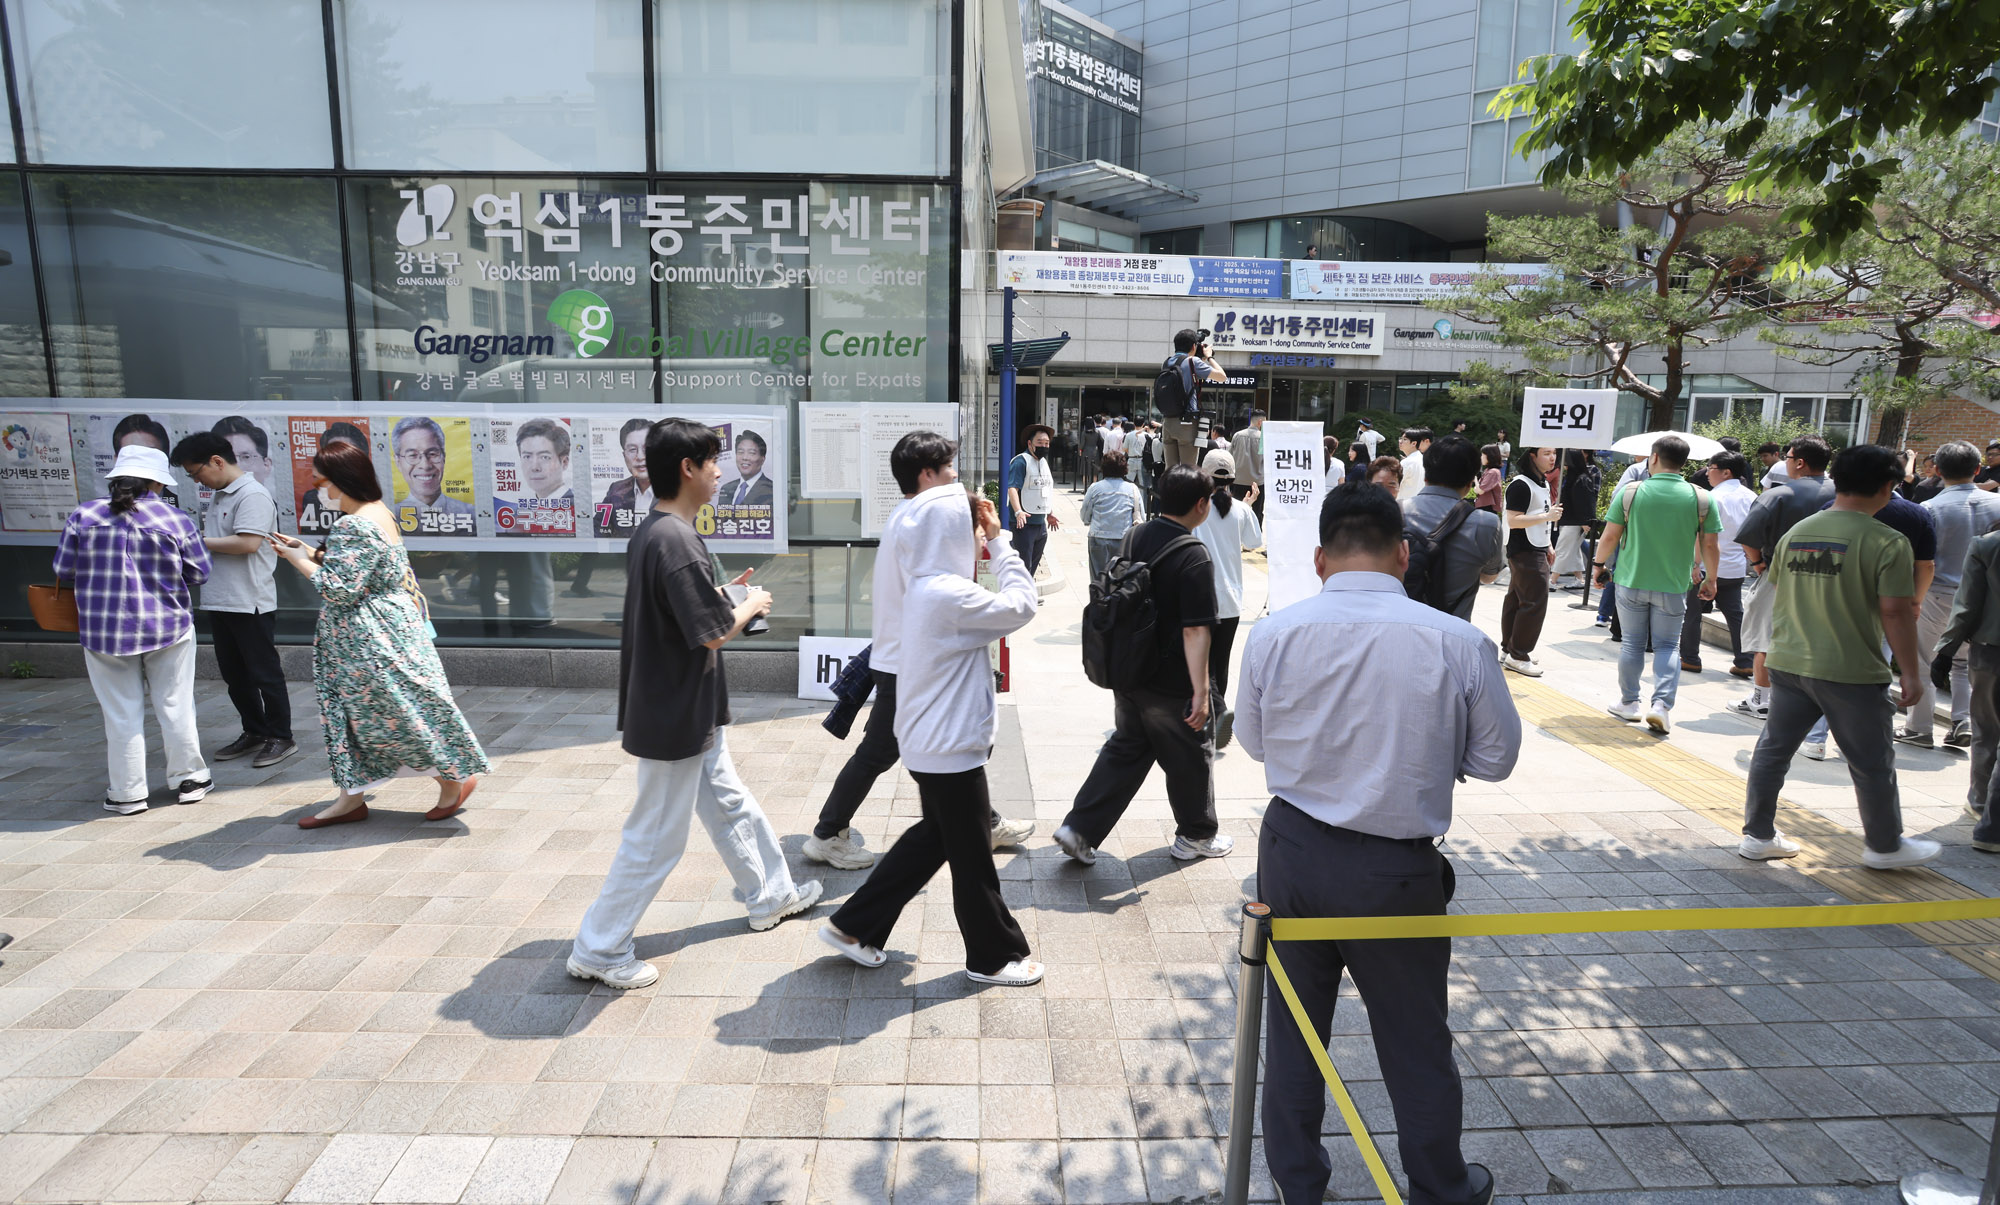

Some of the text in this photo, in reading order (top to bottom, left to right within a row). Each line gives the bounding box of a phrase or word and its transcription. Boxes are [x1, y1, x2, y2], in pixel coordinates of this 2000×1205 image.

[1045, 67, 1066, 84] 1-dong
[1066, 76, 1096, 97] Community
[1097, 89, 1118, 104] Cultural
[1118, 98, 1139, 113] Complex
[472, 191, 930, 256] 역삼1동주민센터
[395, 251, 461, 274] 강남구
[1090, 257, 1122, 268] 분리배출
[1123, 258, 1139, 269] 거점
[477, 260, 926, 286] Yeoksam 1-dong Community Service Center
[1036, 269, 1076, 281] 재활용품을
[1078, 270, 1126, 282] 종량제봉투로
[1153, 272, 1185, 284] 드립니다
[1322, 272, 1344, 284] 세탁
[1346, 272, 1357, 284] 및
[1358, 273, 1369, 284] 짐
[1371, 273, 1392, 284] 보관
[1393, 273, 1424, 285] 서비스
[1241, 314, 1374, 338] 역삼1동주민센터
[1394, 328, 1435, 340] Gangnam
[414, 325, 555, 364] Gangnam
[703, 328, 811, 365] Village
[820, 329, 927, 357] Center
[1213, 334, 1236, 343] 강남구
[1241, 338, 1268, 347] Yeoksam
[1269, 339, 1291, 348] 1-dong
[1292, 340, 1325, 350] Community
[1327, 341, 1349, 349] Service
[1350, 342, 1371, 350] Center
[416, 371, 636, 390] 강남글로벌빌리지센터
[664, 371, 742, 389] Support
[750, 372, 814, 387] Center
[822, 371, 847, 387] for
[856, 373, 921, 388] Expats
[1539, 404, 1595, 431] 관외
[291, 421, 327, 434] 미래를
[292, 434, 316, 447] 여는
[294, 447, 318, 460] 선택
[1274, 449, 1312, 470] 관내
[0, 468, 70, 480] 선거벽보 주의문
[496, 469, 516, 481] 정치
[496, 481, 521, 492] 교체!
[1275, 478, 1313, 493] 선거인
[299, 503, 320, 531] 4
[400, 506, 419, 532] 5
[420, 512, 474, 533] 권영국
[497, 506, 516, 530] 6
[517, 509, 575, 531] 구주와
[595, 503, 613, 527] 7
[695, 504, 716, 535] 8
[750, 510, 771, 518] 해결사
[722, 519, 771, 535] 송진호
